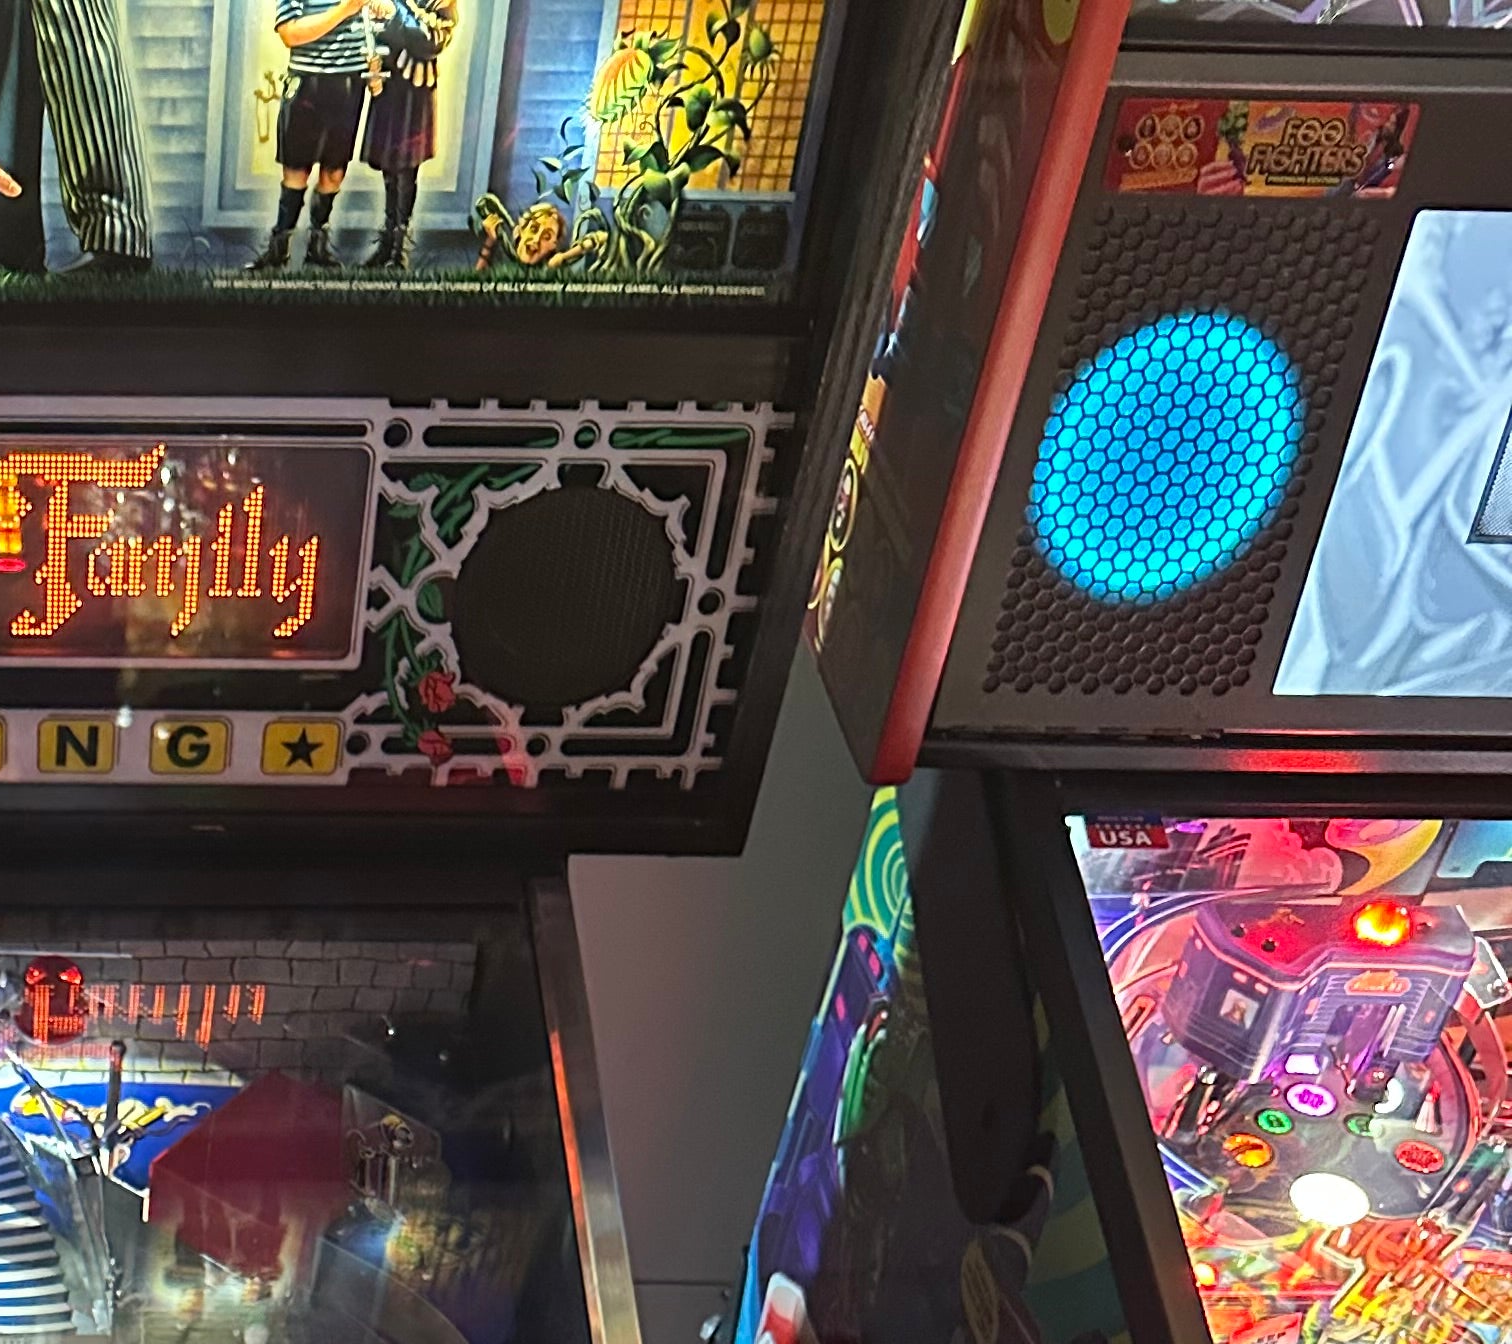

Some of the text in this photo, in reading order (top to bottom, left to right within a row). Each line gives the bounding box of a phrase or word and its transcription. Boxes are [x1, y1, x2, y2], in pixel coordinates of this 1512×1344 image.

[1282, 117, 1346, 146] FOO
[1246, 142, 1368, 176] FIGHTERS
[1097, 830, 1153, 846] USA
